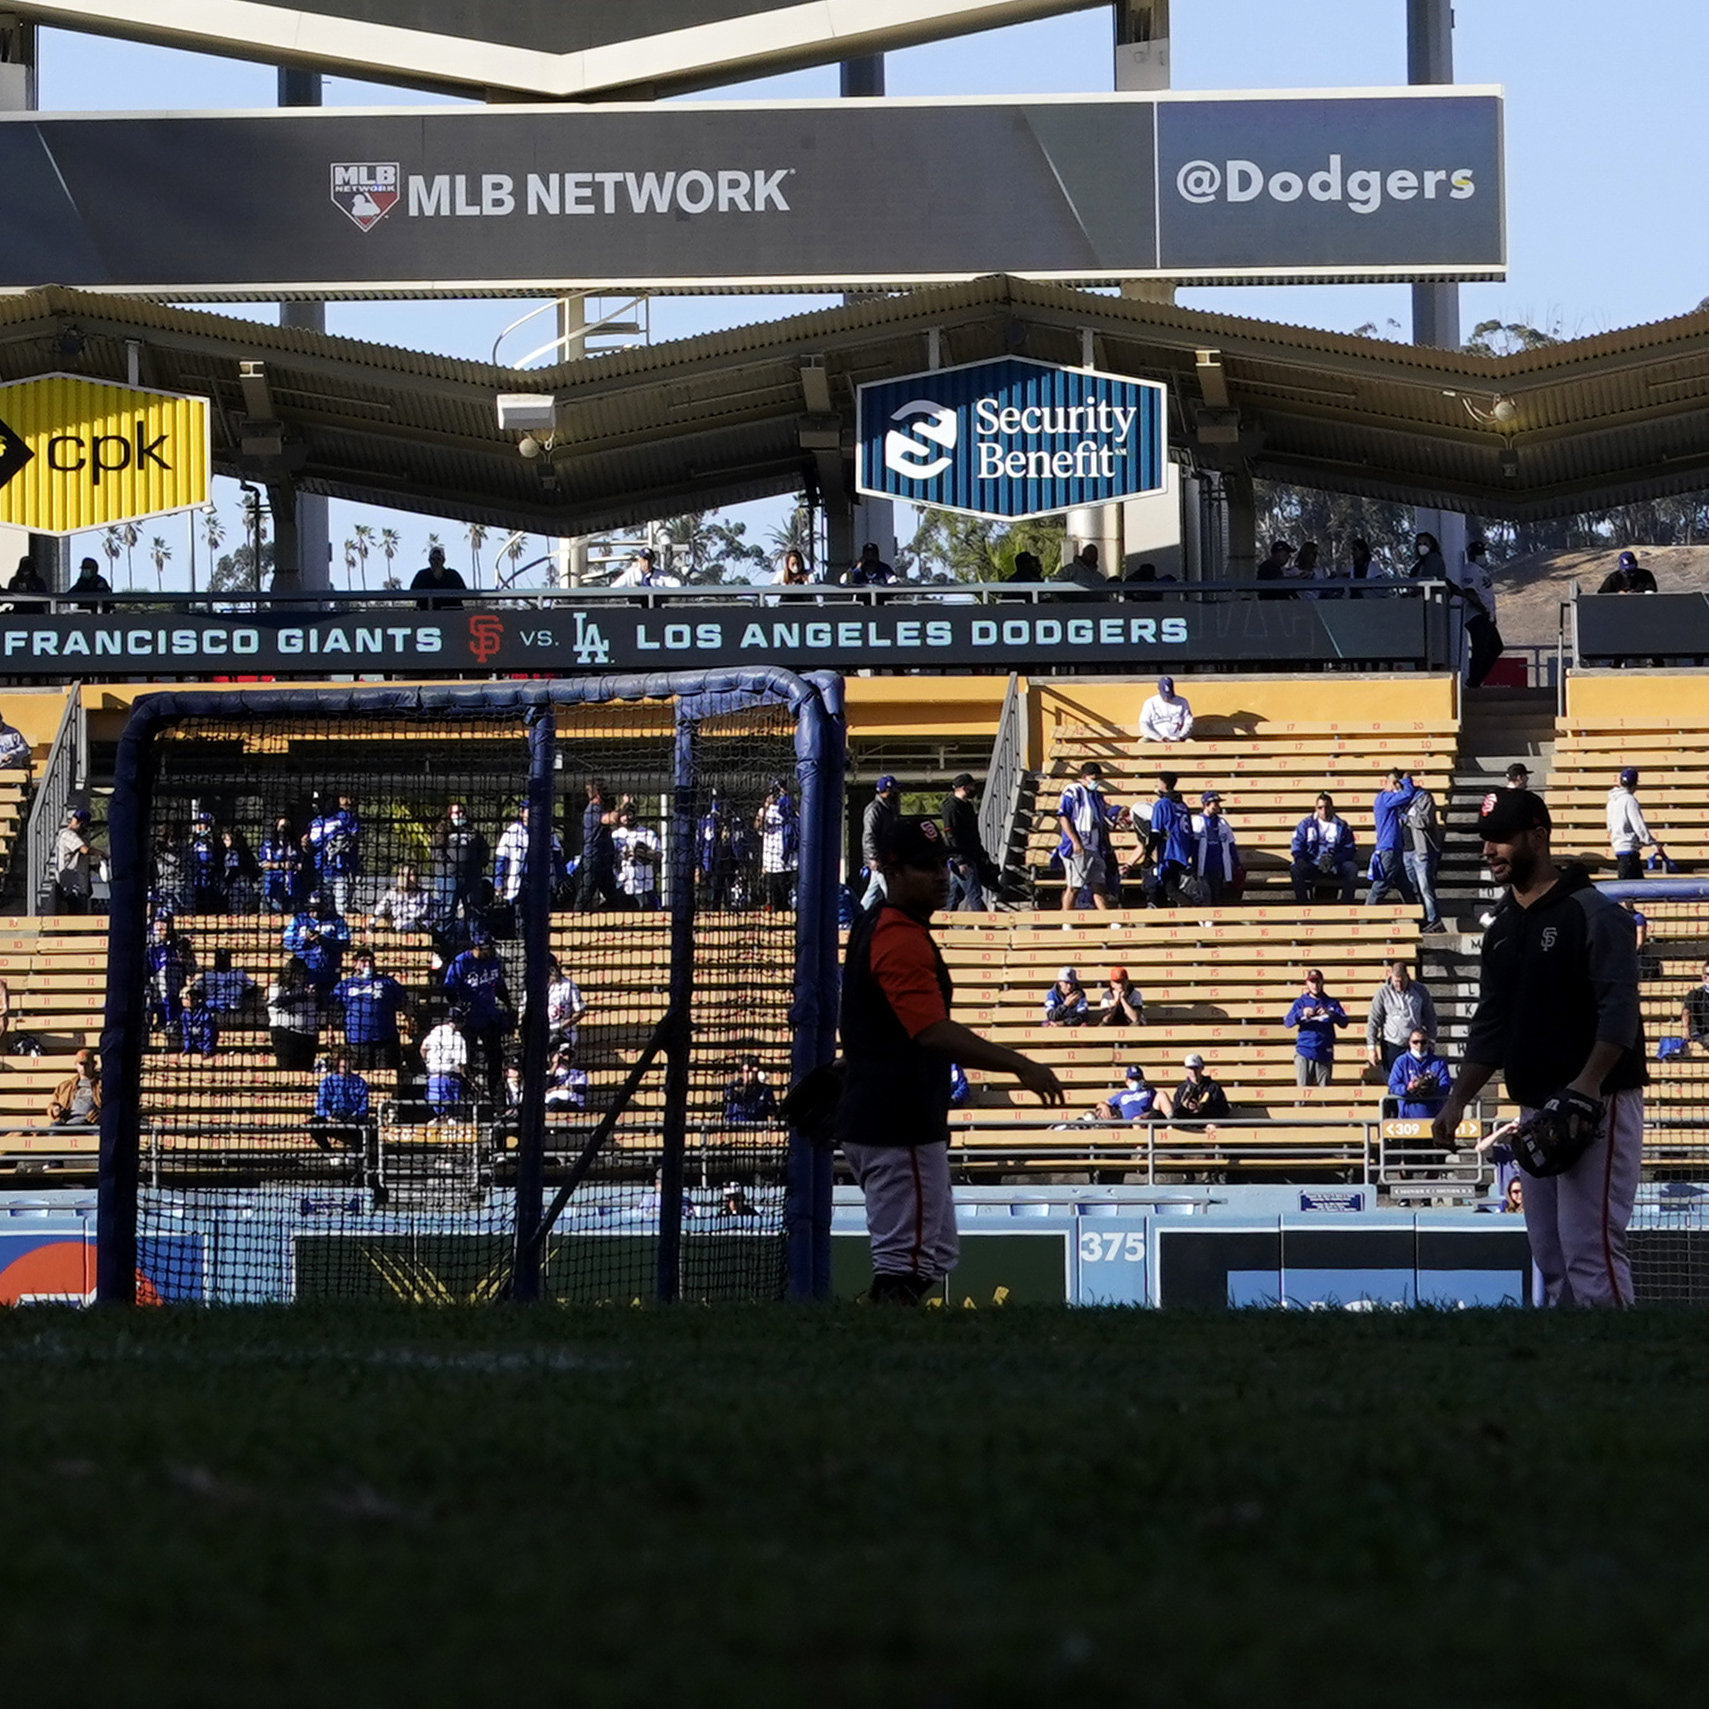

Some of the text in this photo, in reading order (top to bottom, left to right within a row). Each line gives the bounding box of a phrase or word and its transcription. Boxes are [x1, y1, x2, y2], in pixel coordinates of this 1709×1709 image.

[334, 166, 397, 185] MLB
[408, 171, 790, 217] MLB NETWORK
[1176, 153, 1475, 214] @Dodgers
[976, 396, 1137, 445] Security
[46, 431, 171, 485] cpk
[4, 628, 259, 656] FRANCISCO
[277, 627, 442, 654] GIANTS
[469, 615, 504, 663] SF
[573, 612, 610, 664] LA
[636, 617, 1188, 650] LOS ANGELES DODGERS
[1540, 927, 1559, 953] SF
[1395, 1122, 1420, 1135] 309
[1079, 1230, 1145, 1262] 375
